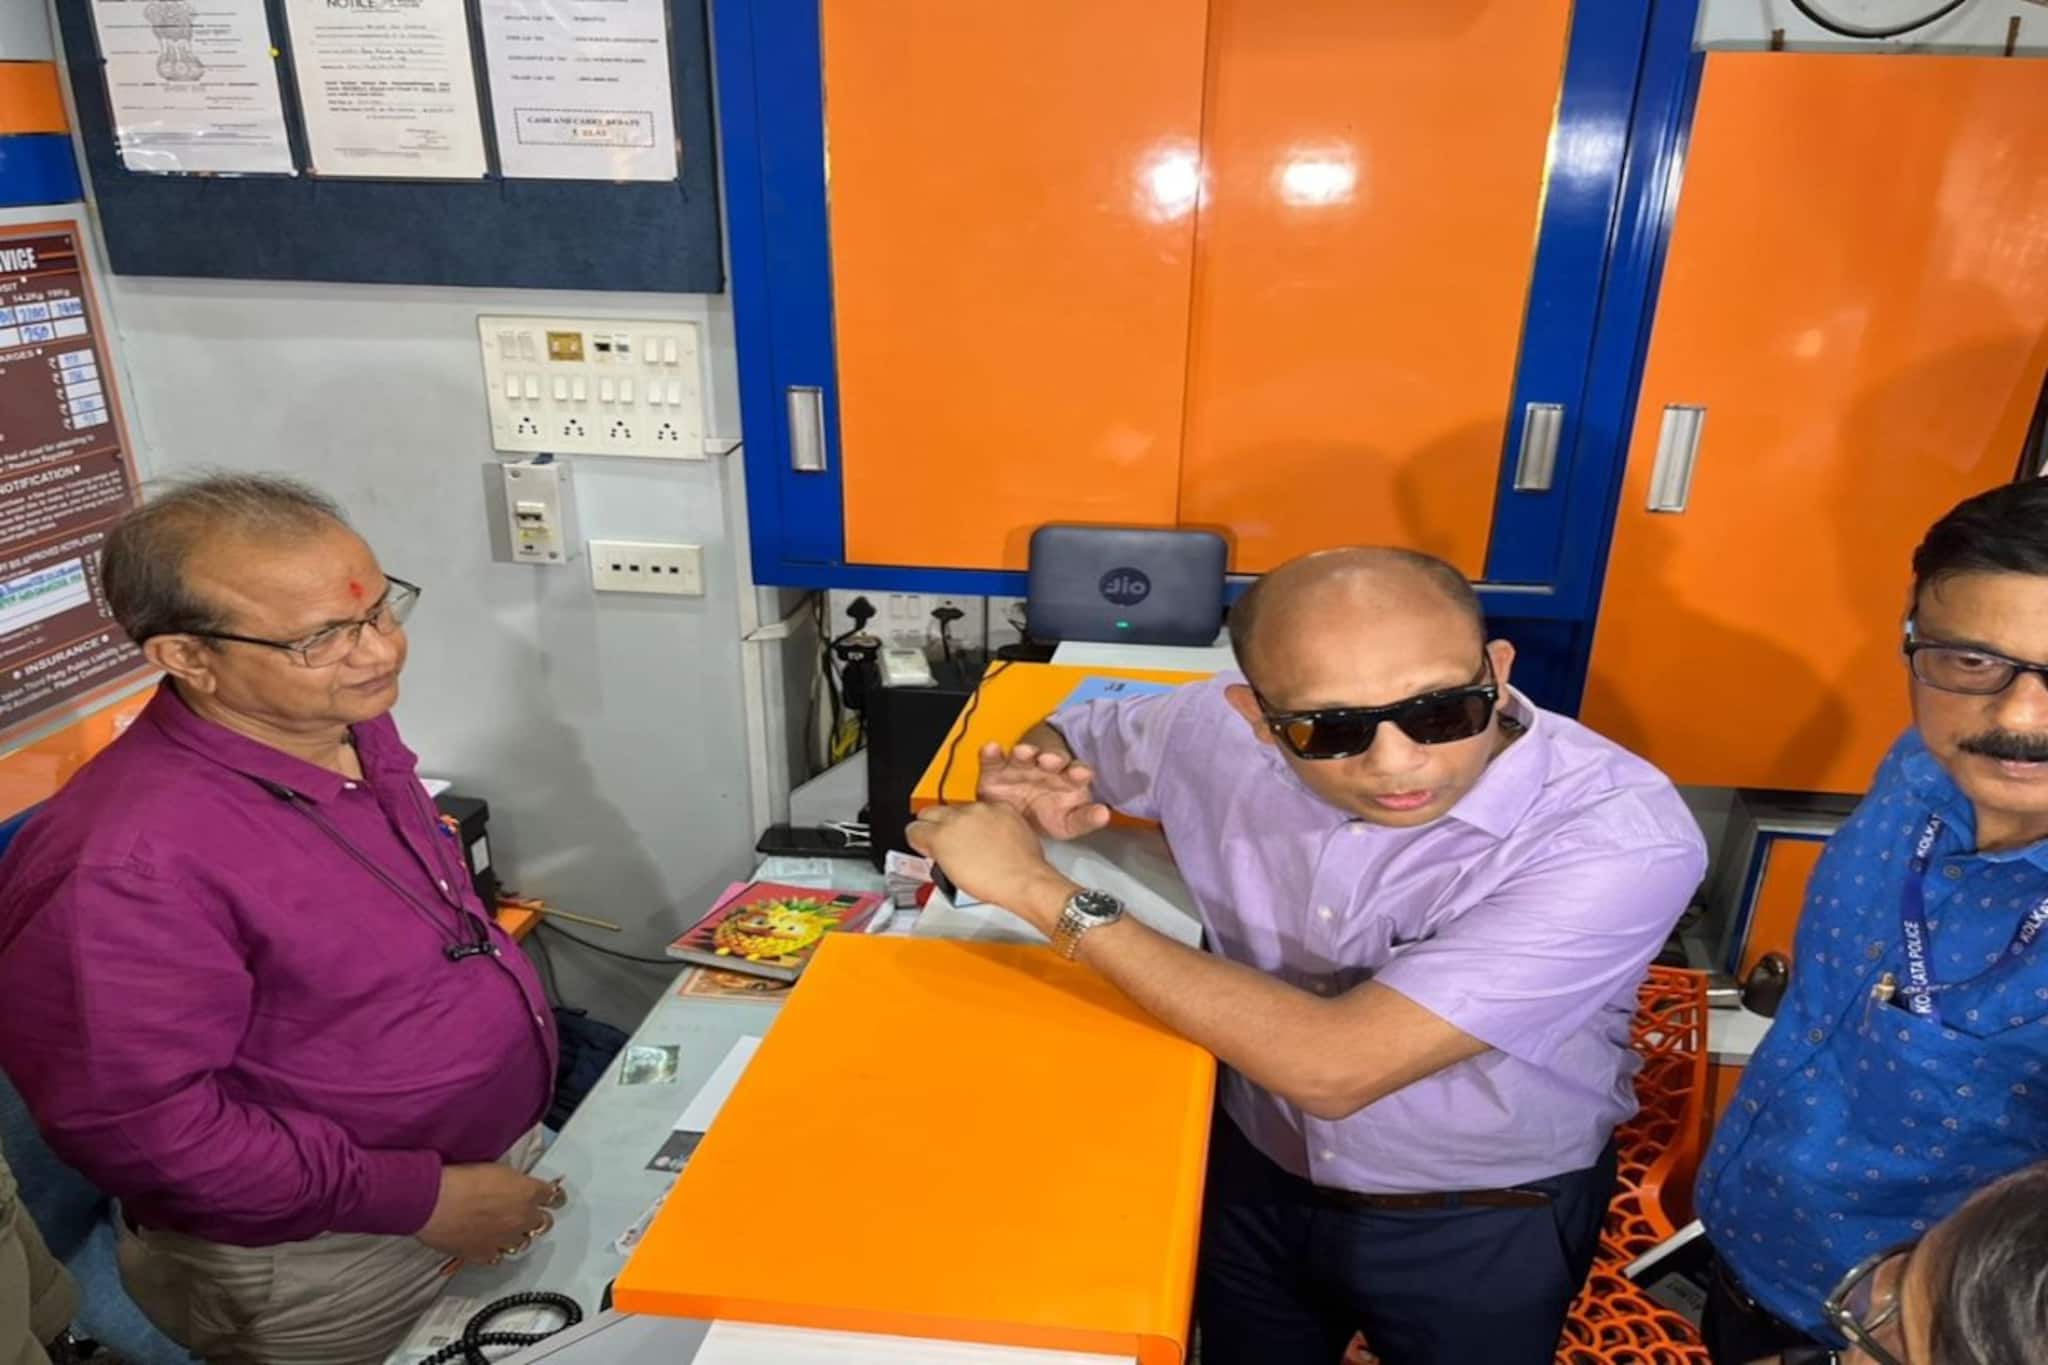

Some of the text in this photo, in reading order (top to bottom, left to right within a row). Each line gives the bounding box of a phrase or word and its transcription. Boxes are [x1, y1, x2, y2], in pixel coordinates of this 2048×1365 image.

[1105, 576, 1147, 595] Jio
[24, 637, 99, 676] INSURANCE
[1903, 920, 1924, 961] POLICE
